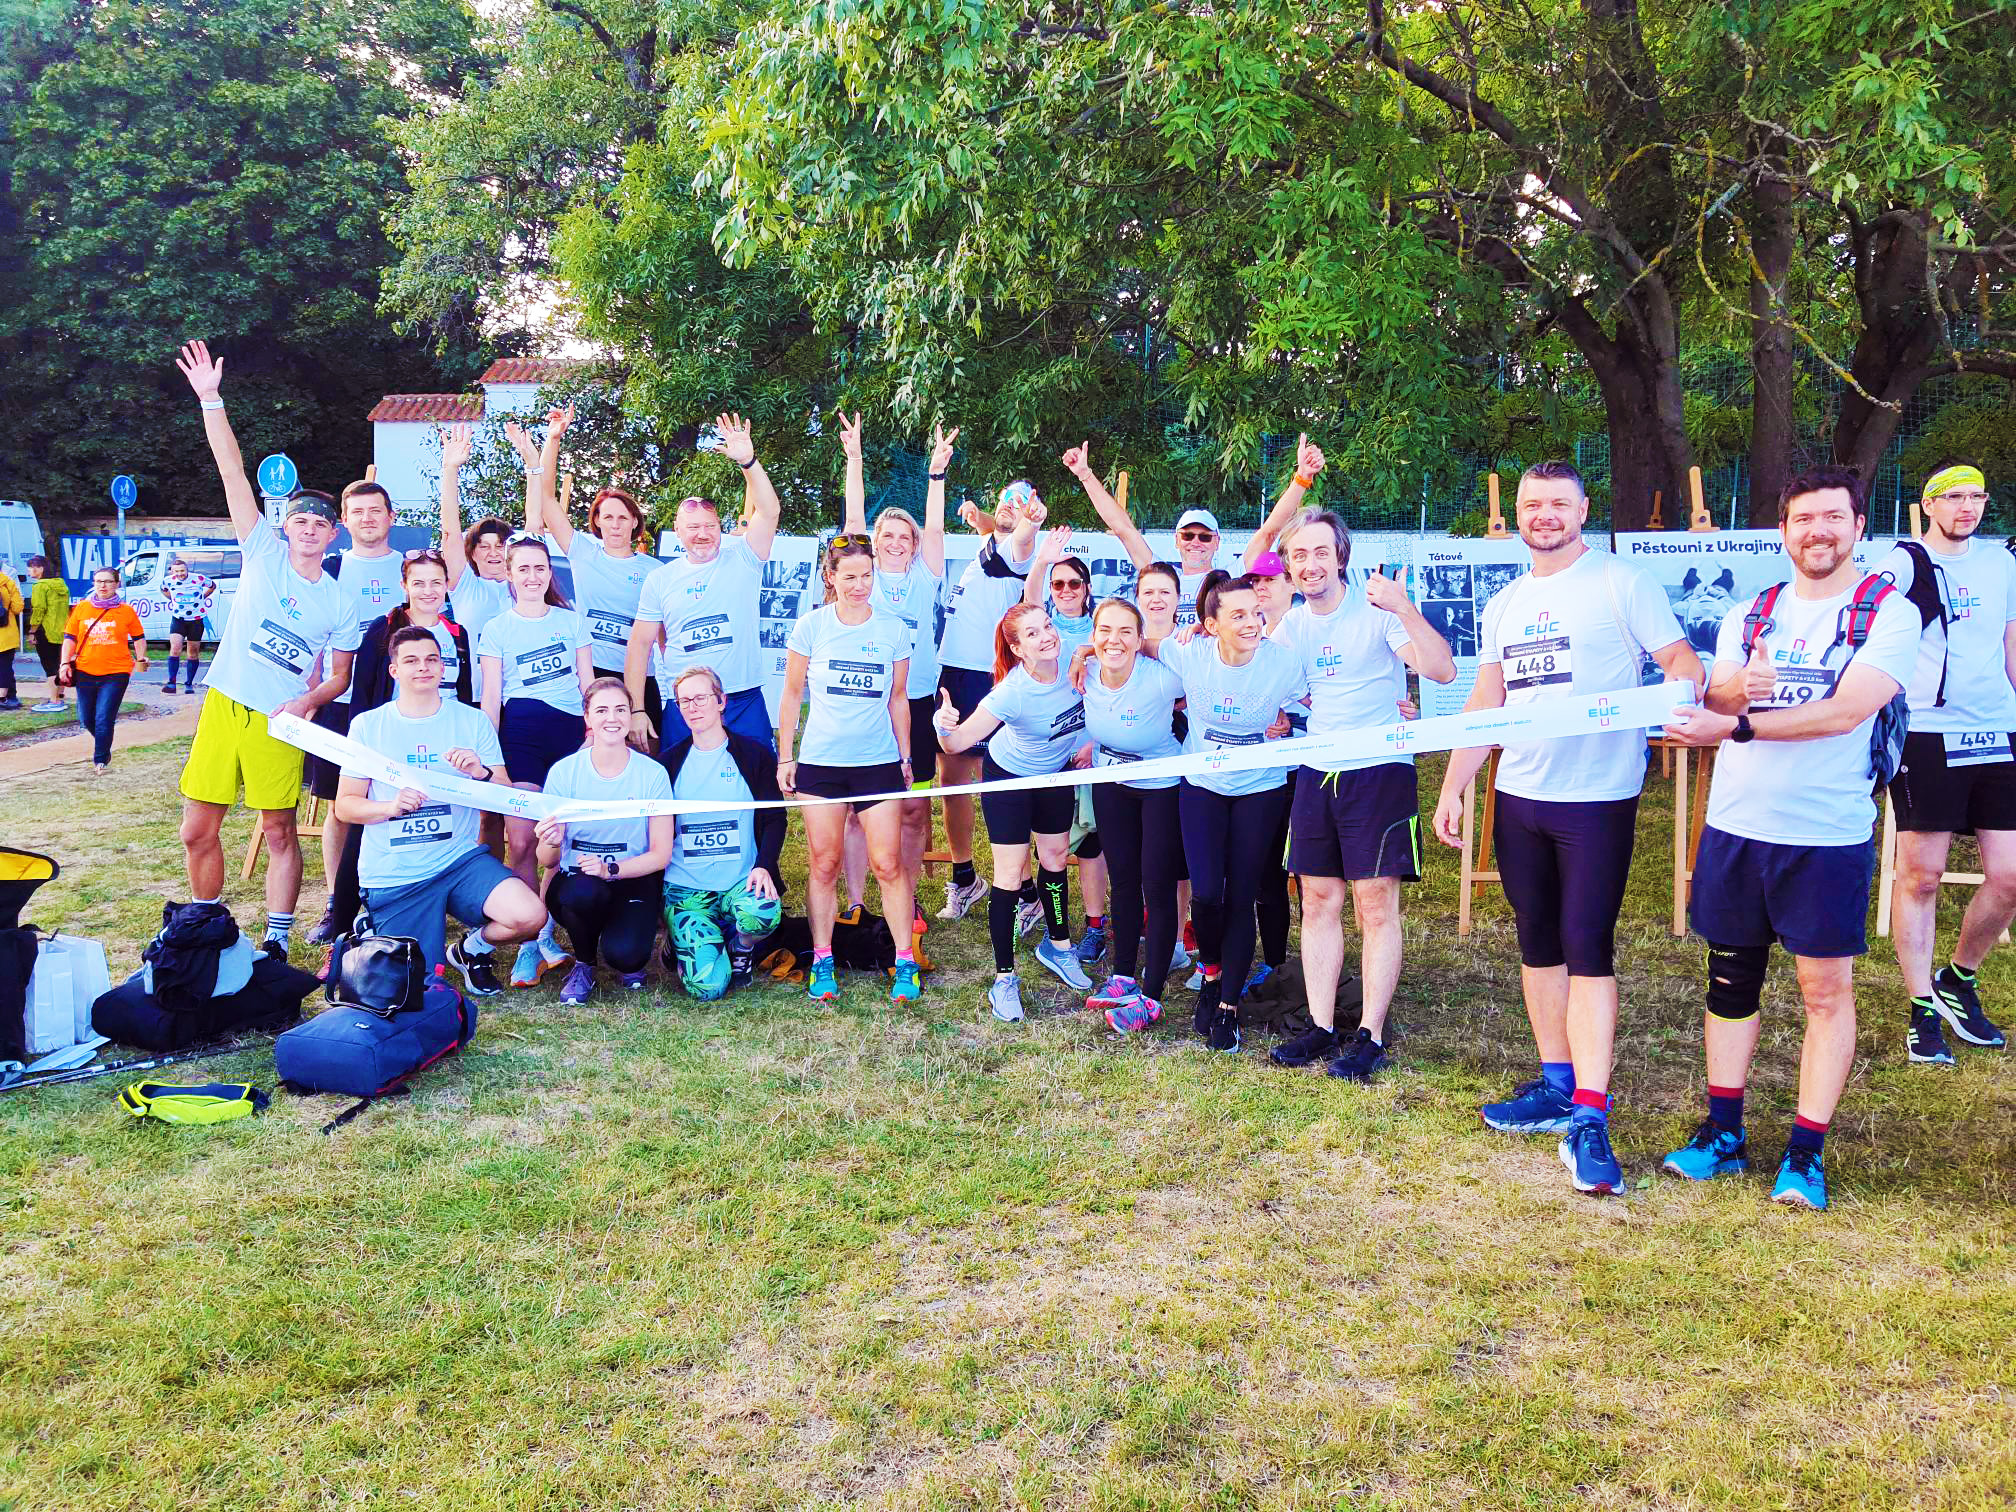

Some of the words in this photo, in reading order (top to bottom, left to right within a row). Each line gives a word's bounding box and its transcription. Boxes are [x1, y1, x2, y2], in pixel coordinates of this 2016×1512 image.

[1064, 545, 1089, 554] chvíli
[1632, 540, 1702, 554] Pěstouni
[1705, 543, 1713, 553] z
[1717, 540, 1783, 555] Ukrajiny
[1428, 552, 1463, 561] Tátové
[361, 587, 391, 595] EUC
[1178, 614, 1196, 624] 48
[594, 620, 622, 637] 451
[692, 626, 720, 641] 439
[1524, 621, 1560, 636] EUC
[265, 636, 300, 661] 439
[1316, 654, 1343, 667] EUC
[1774, 649, 1812, 665] EUC
[531, 656, 562, 674] 450
[1516, 655, 1555, 676] 448
[839, 673, 873, 688] 448
[1213, 704, 1241, 715] EUC
[1588, 706, 1620, 717] EUC
[285, 725, 301, 736] EUC
[1386, 731, 1415, 742] EUC
[1959, 732, 1996, 747] 449
[406, 753, 438, 763] EUC
[1205, 753, 1231, 762] EUC
[386, 766, 401, 777] EUC
[508, 798, 529, 807] EUC
[401, 818, 440, 834] 450
[693, 833, 728, 847] 450
